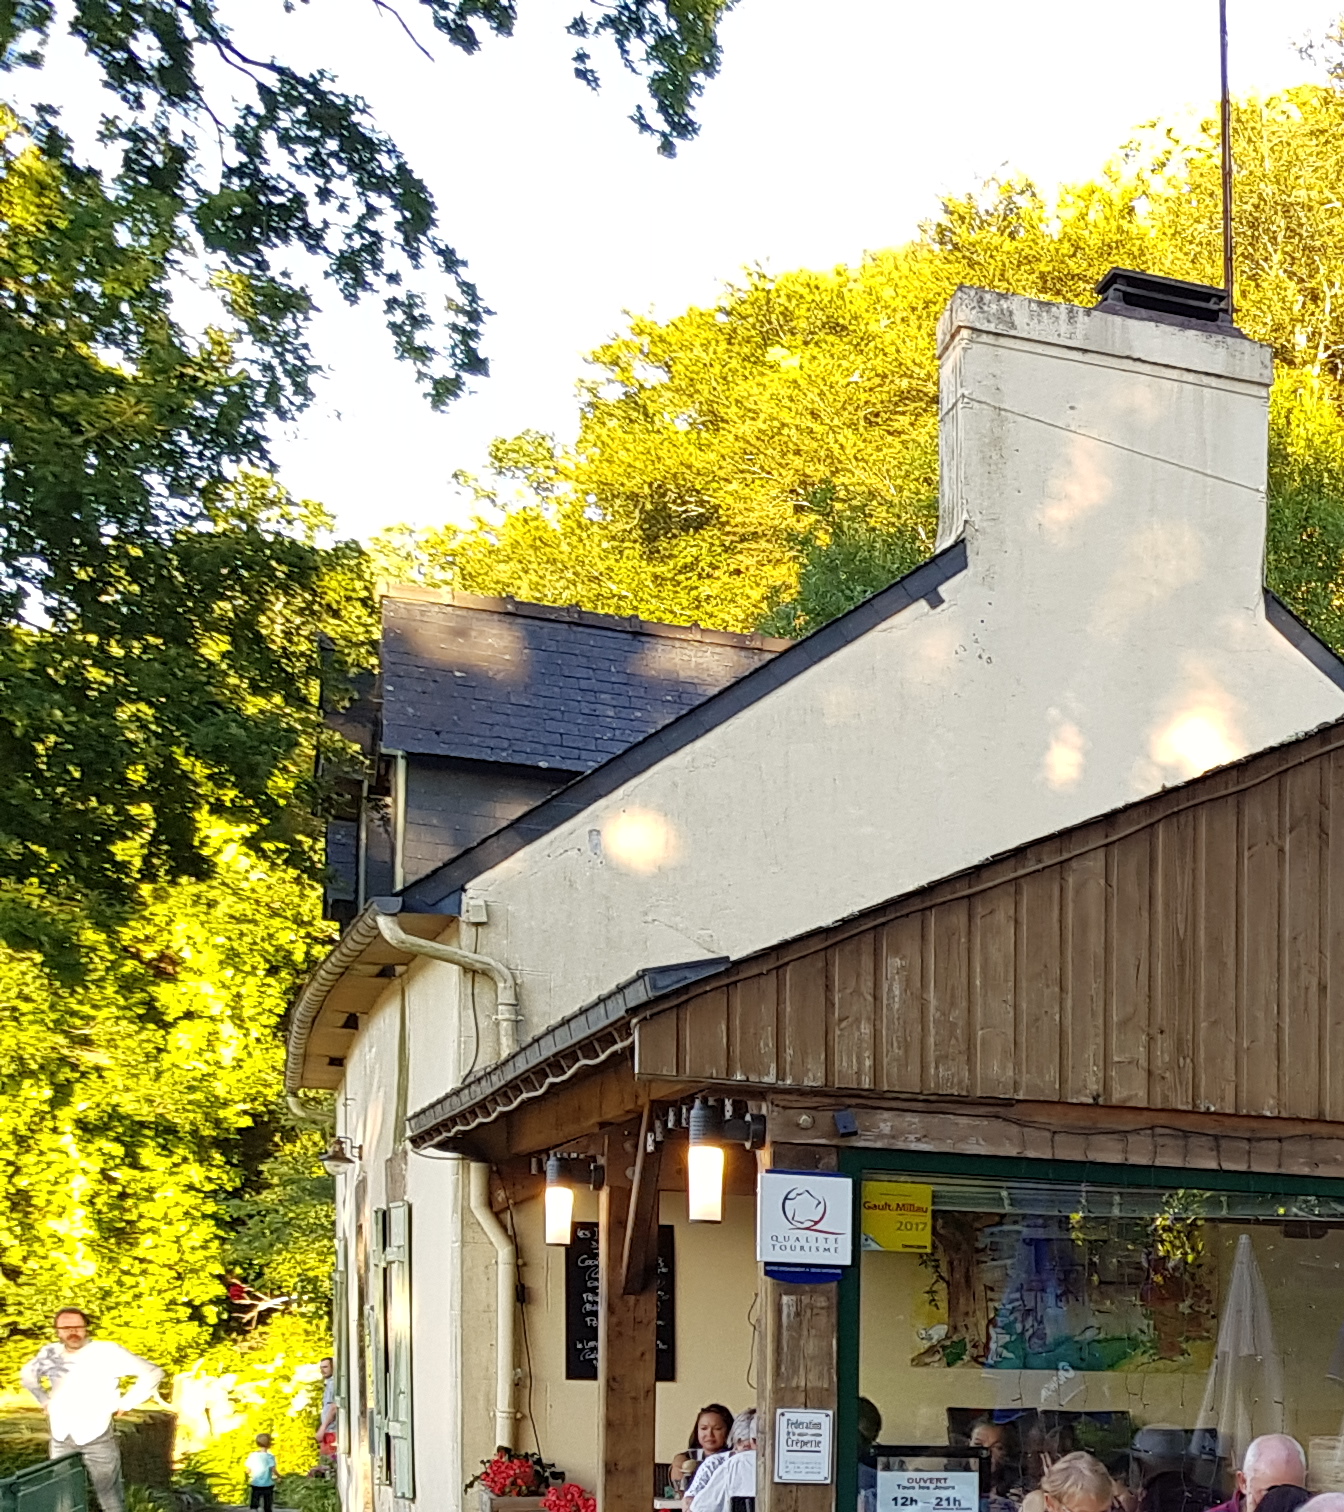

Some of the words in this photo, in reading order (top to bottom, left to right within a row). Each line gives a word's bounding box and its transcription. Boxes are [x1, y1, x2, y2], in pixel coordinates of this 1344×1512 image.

[896, 1221, 928, 1232] 2017
[771, 1244, 839, 1253] TOURISME
[906, 1477, 949, 1485] OUVERT
[891, 1496, 918, 1507] 12h
[934, 1496, 961, 1507] 21h
